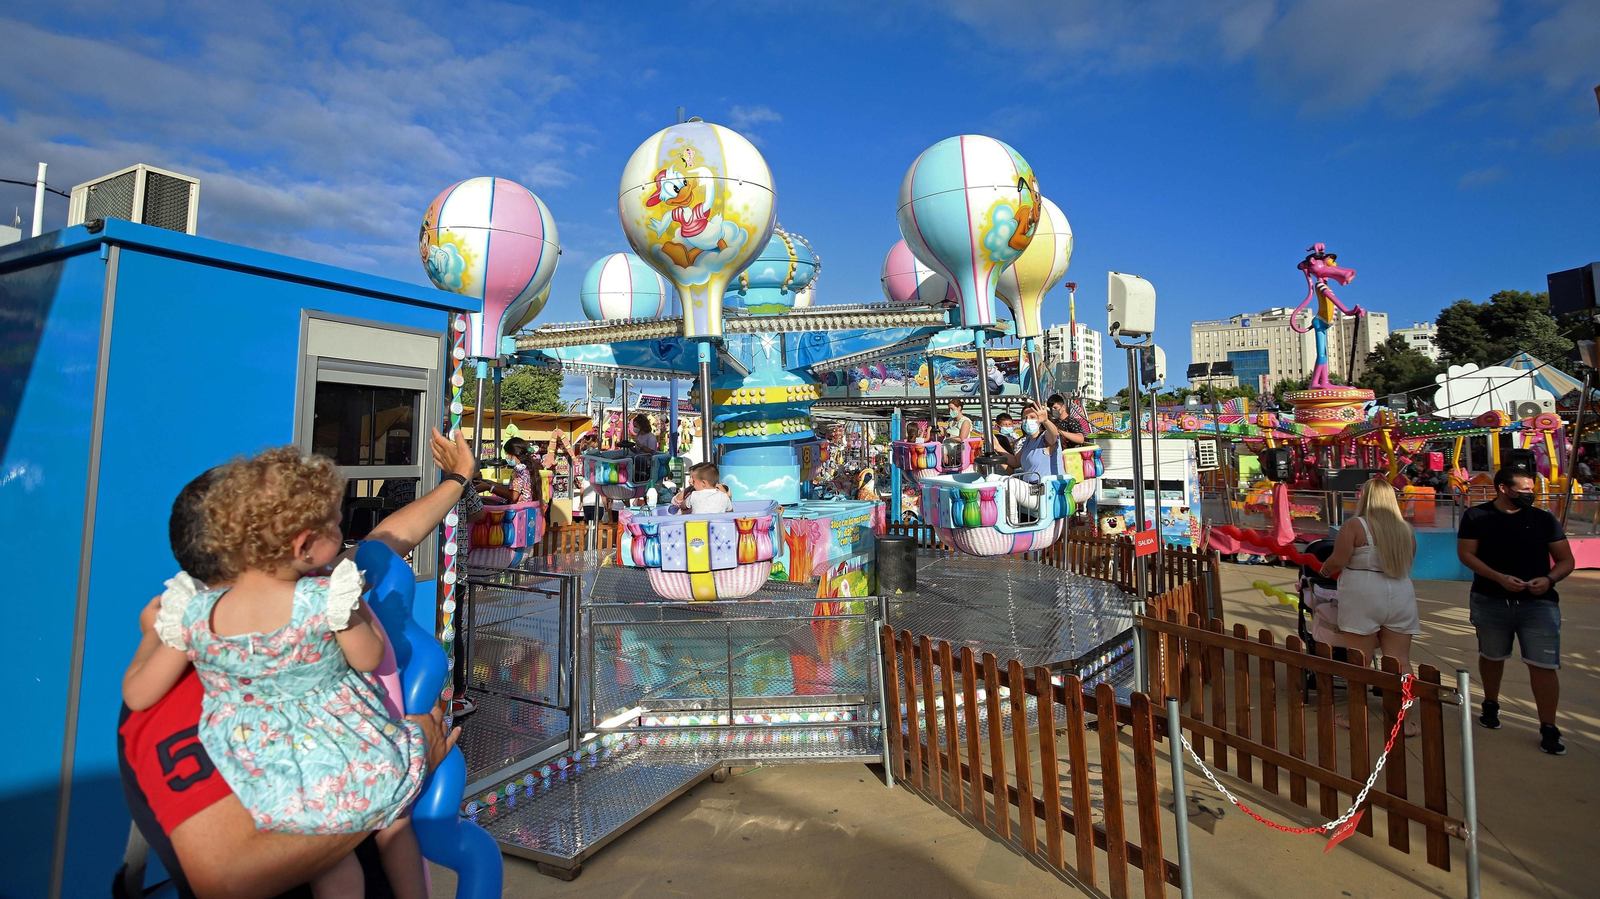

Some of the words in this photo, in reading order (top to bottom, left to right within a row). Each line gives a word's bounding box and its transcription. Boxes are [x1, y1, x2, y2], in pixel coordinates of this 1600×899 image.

[1137, 538, 1155, 547] SALIDA
[156, 723, 217, 793] 5
[1331, 821, 1354, 840] SALIDA
